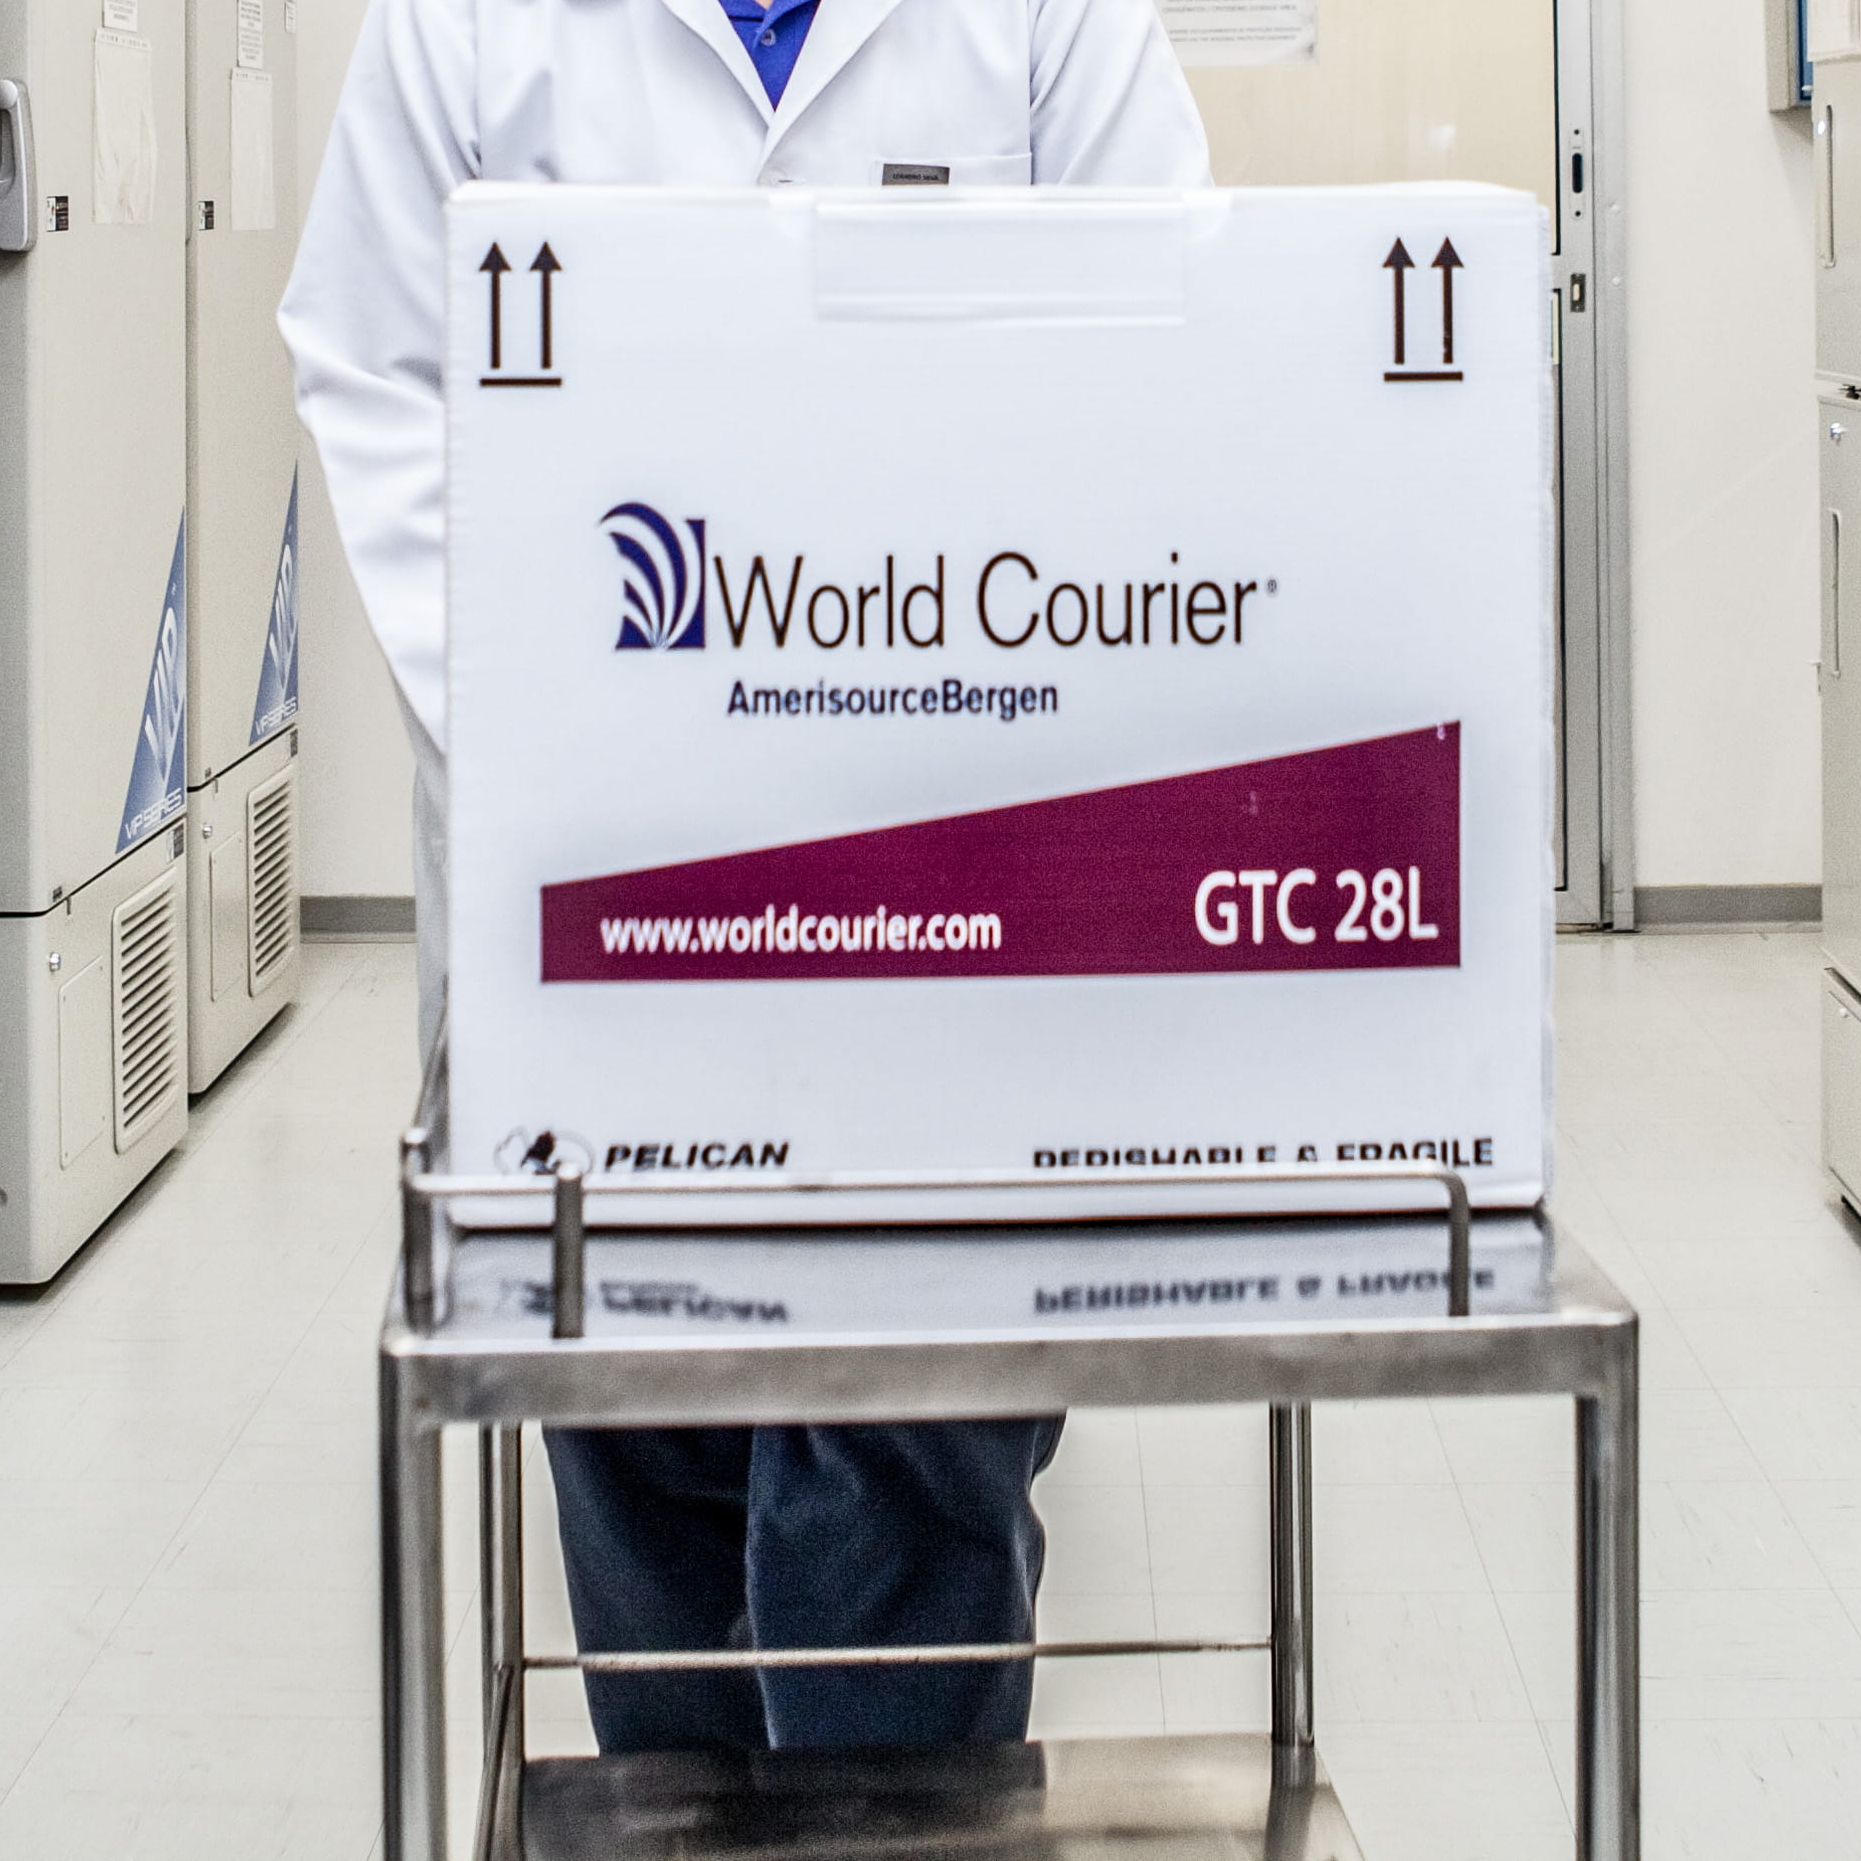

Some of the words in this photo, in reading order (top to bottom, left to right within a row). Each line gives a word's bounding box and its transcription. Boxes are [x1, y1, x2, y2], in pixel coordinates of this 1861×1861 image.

[714, 553, 945, 648] World
[727, 677, 1059, 721] AmerisourceBergen
[600, 904, 1002, 956] www.worldcourier.com
[1195, 869, 1317, 946] GTC
[1333, 865, 1439, 942] 28L
[604, 1141, 789, 1171] PELICAN
